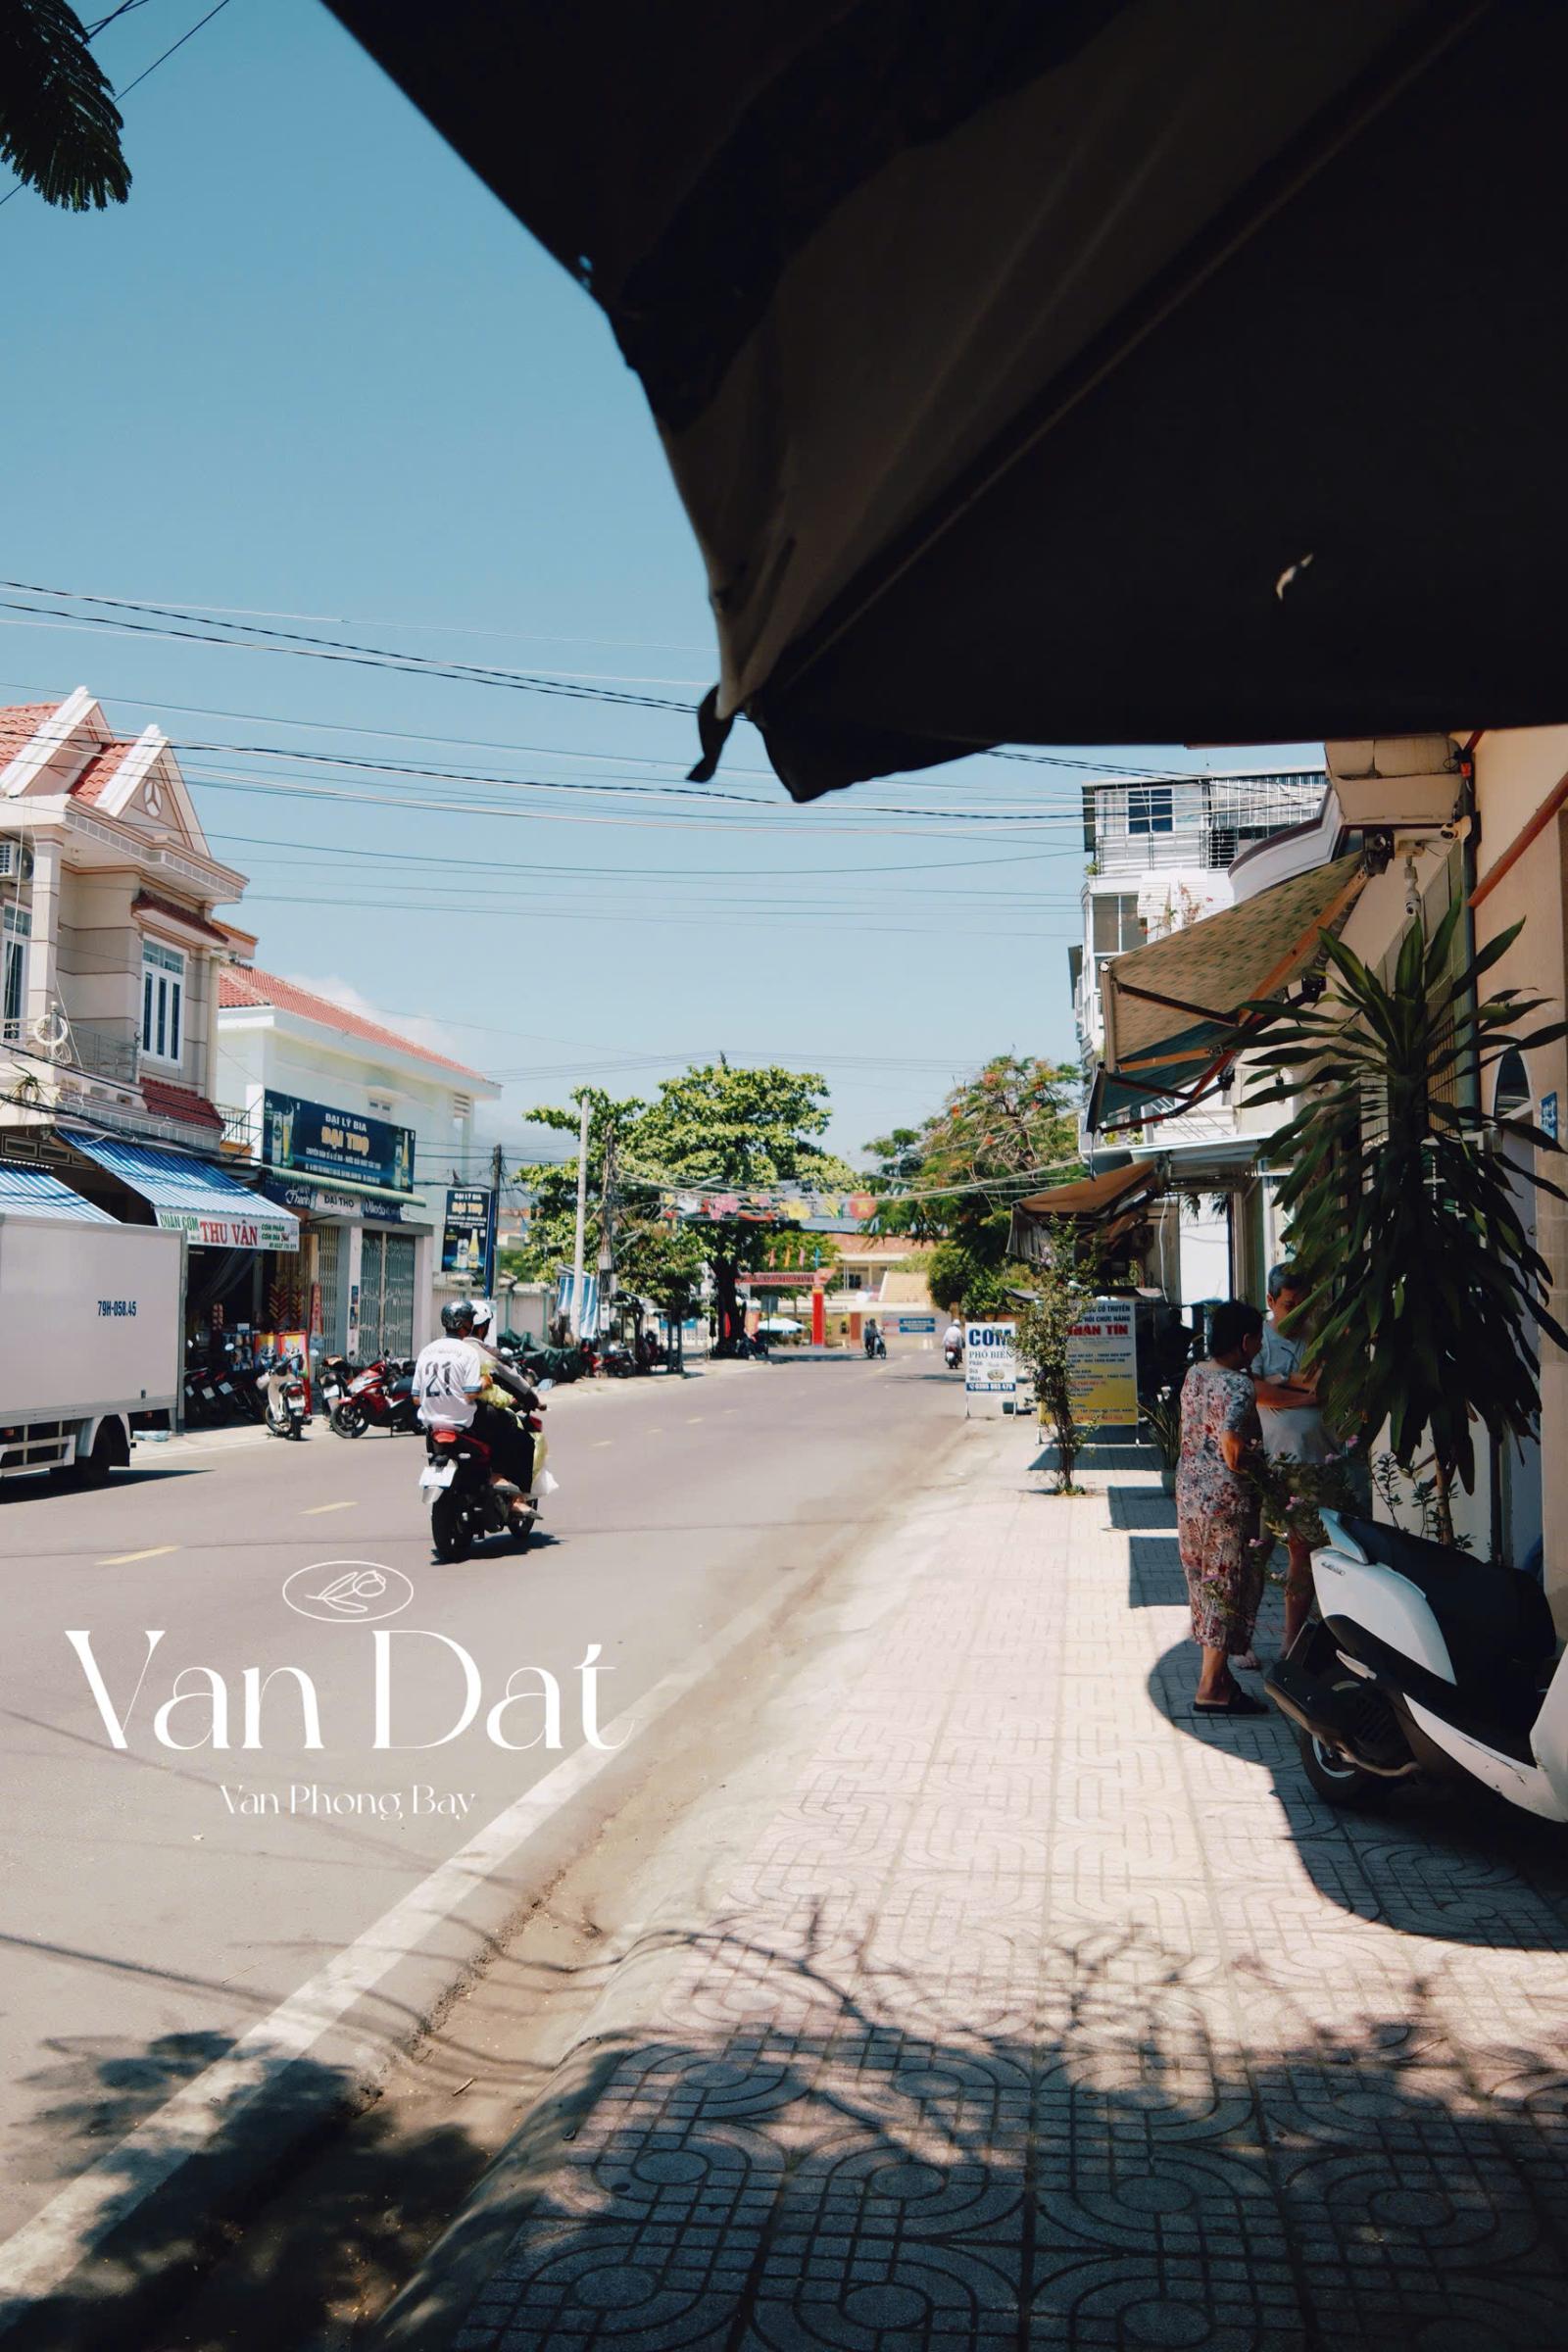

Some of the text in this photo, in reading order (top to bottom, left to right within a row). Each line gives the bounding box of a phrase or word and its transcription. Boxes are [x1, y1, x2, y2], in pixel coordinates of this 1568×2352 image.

[353, 1121, 367, 1132] BIA
[200, 1219, 258, 1247] THU VÂN
[97, 1300, 137, 1316] 79H-058.45
[424, 1361, 453, 1397] 21
